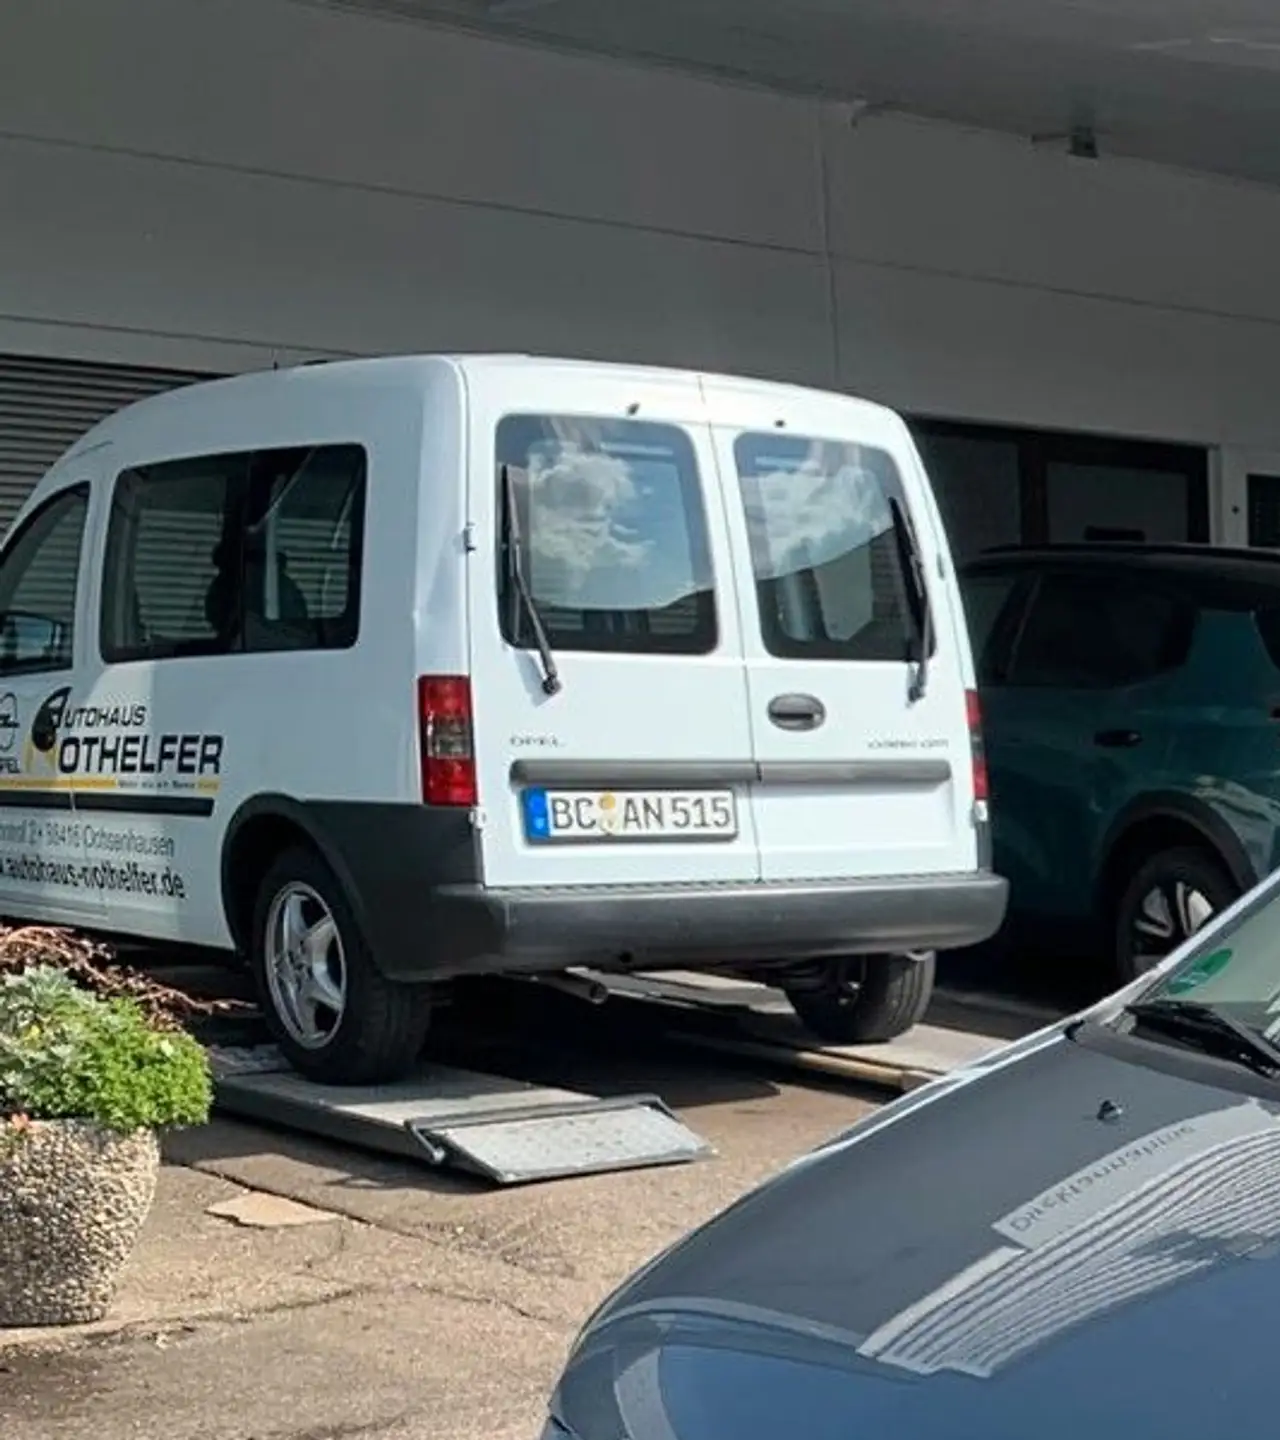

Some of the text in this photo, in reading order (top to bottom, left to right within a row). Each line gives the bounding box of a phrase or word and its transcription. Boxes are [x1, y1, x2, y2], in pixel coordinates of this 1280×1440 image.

[551, 796, 731, 830] BC AN 515
